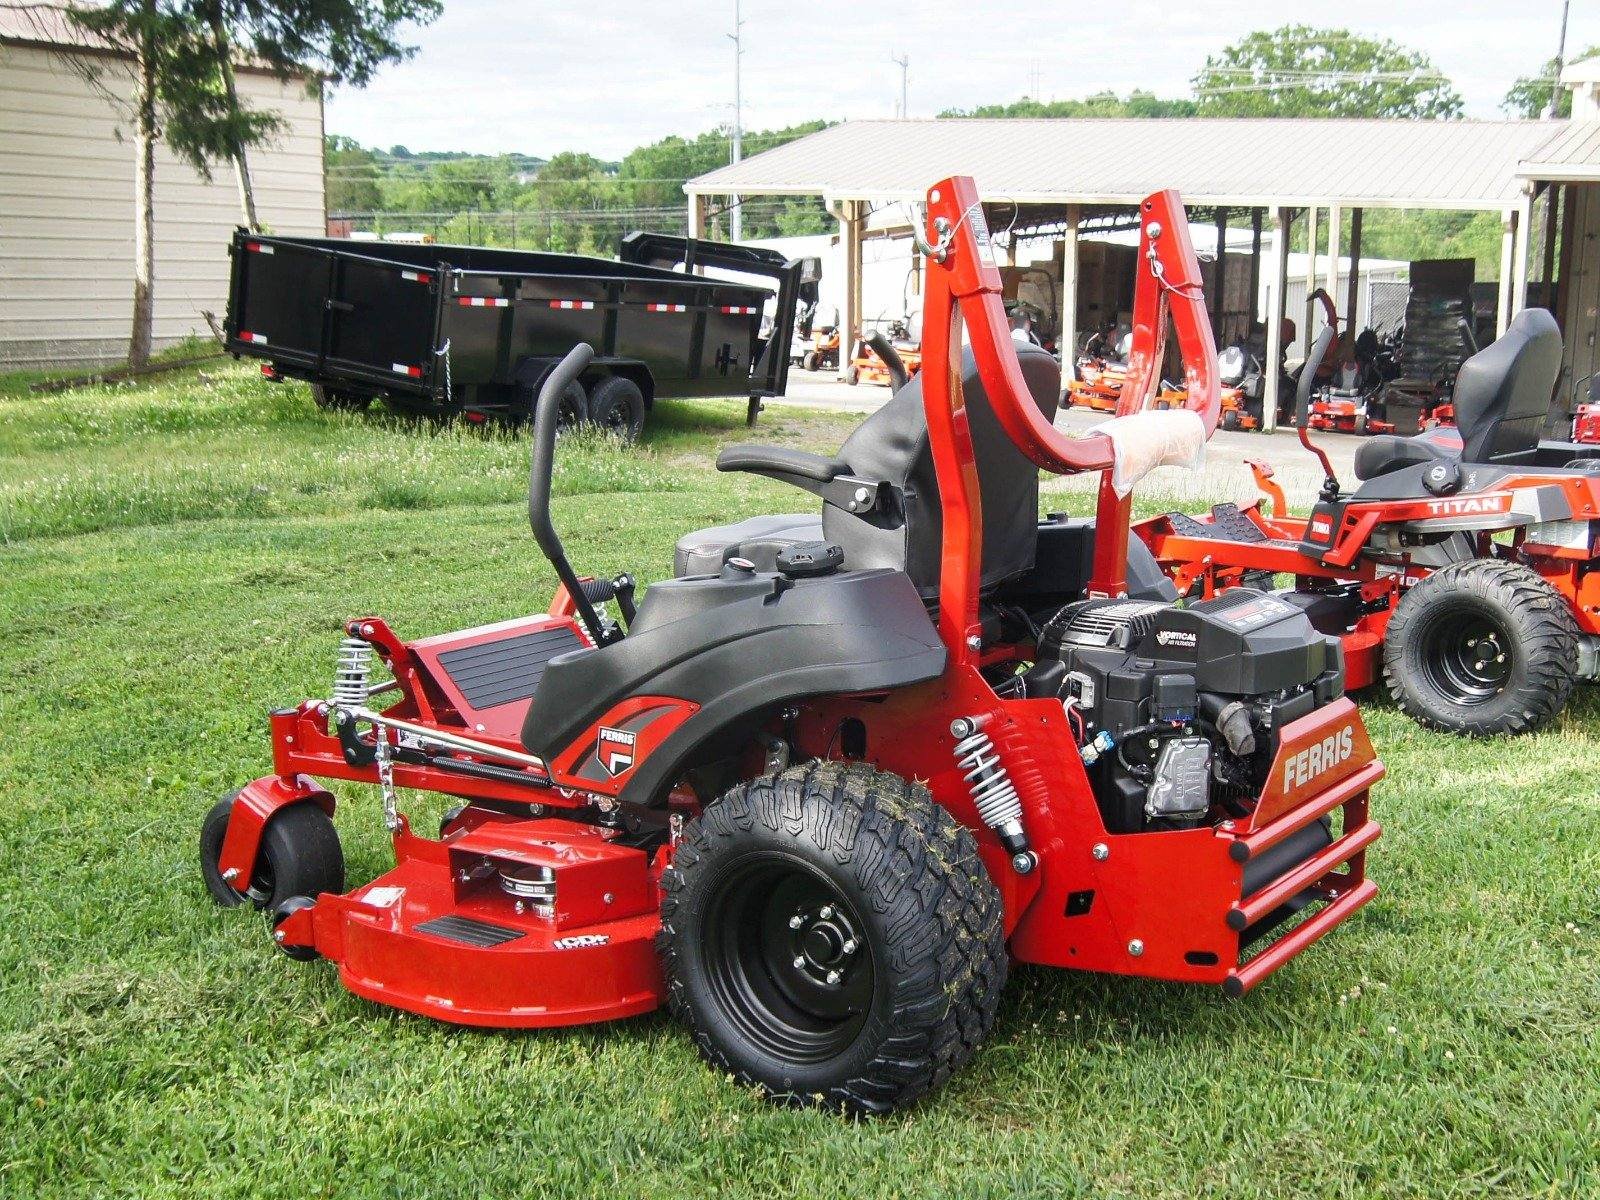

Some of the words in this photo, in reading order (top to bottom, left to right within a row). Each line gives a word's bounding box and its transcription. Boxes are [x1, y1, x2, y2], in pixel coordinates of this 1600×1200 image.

[1427, 497, 1499, 515] TITAN
[1159, 631, 1197, 642] VORTICAL
[601, 729, 634, 745] FERRIS
[1283, 725, 1353, 795] FERRIS
